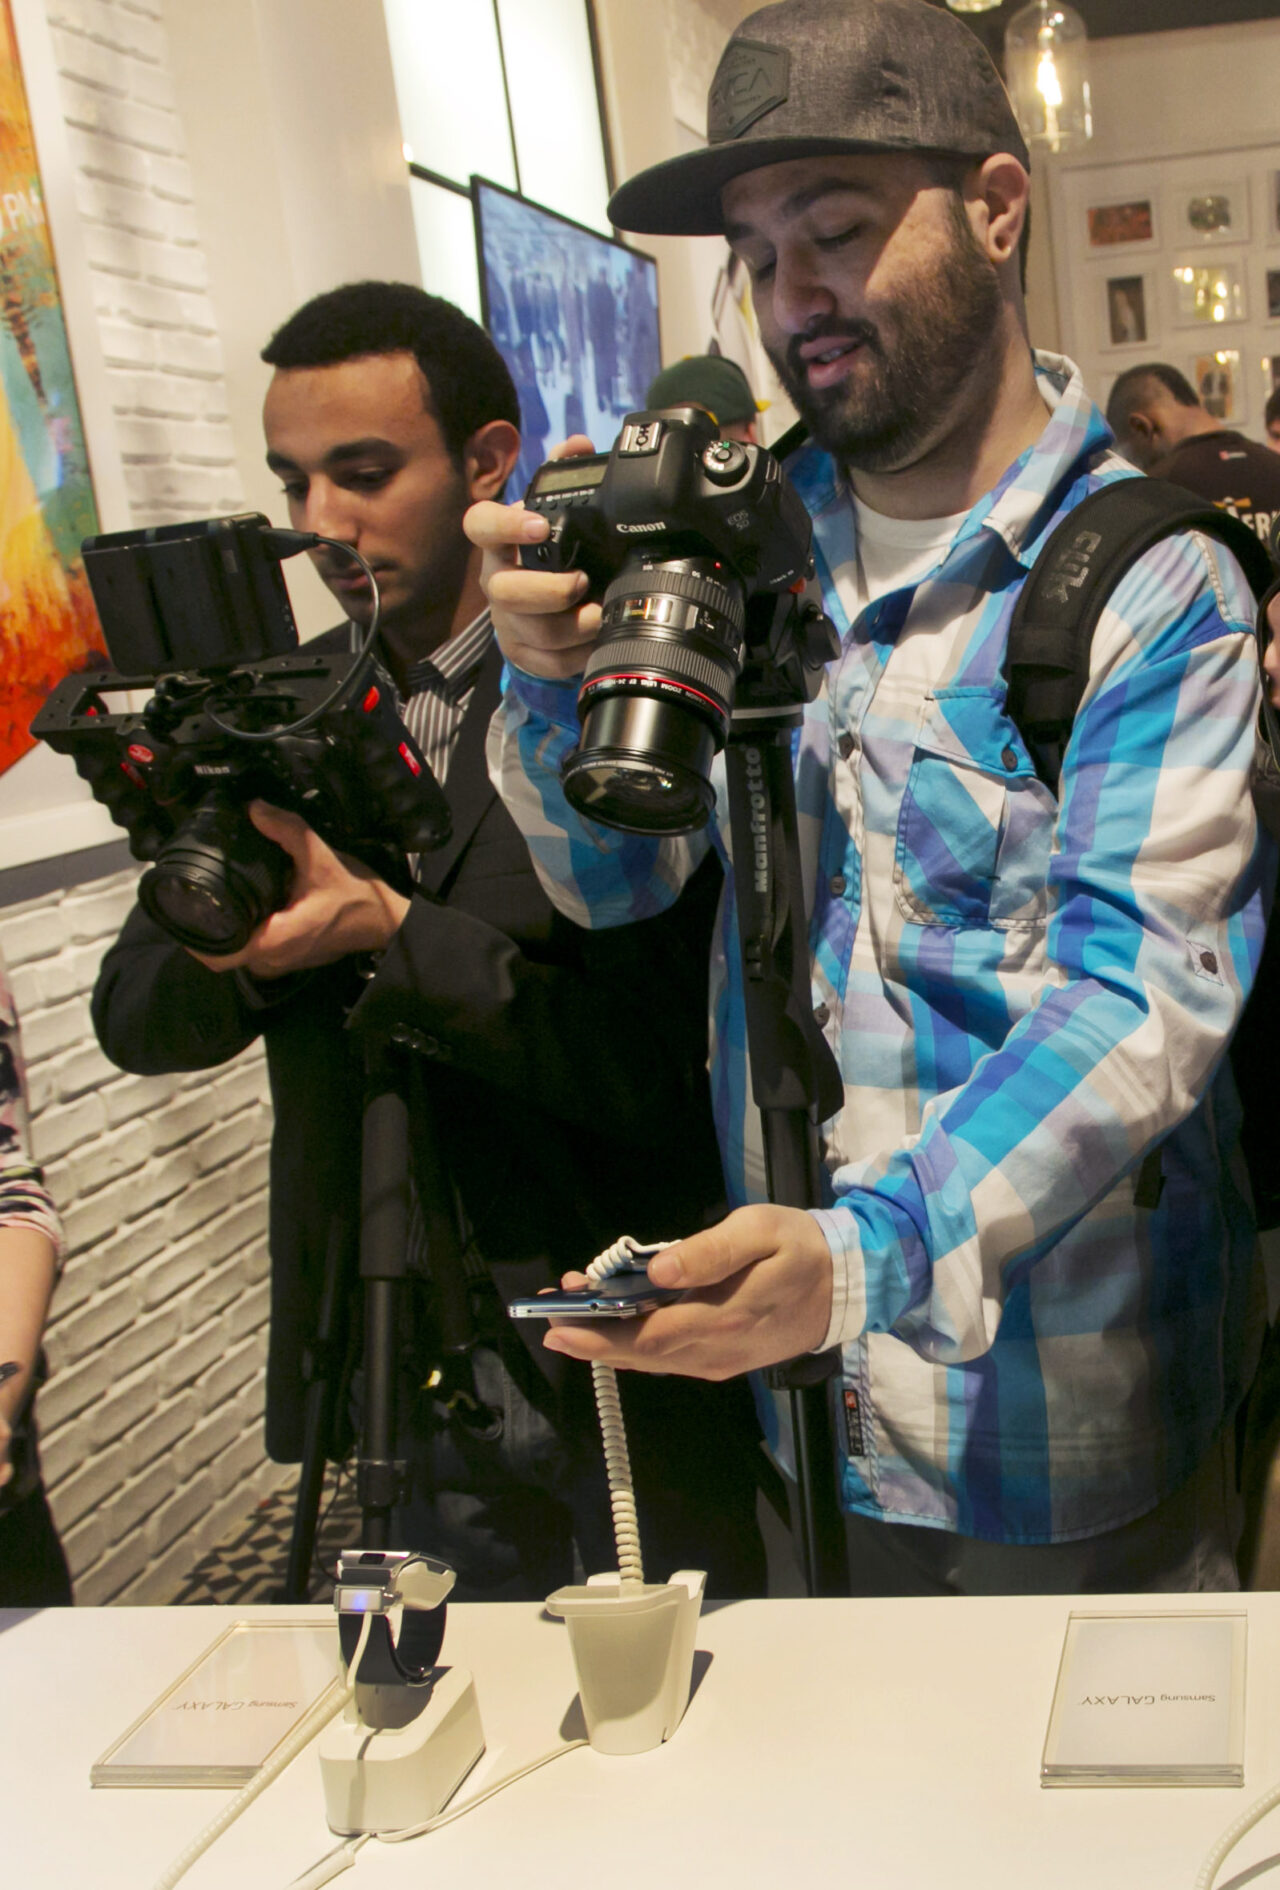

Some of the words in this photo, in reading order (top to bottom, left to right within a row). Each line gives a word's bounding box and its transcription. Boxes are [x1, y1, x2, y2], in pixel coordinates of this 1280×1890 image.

[727, 509, 749, 526] EOS
[616, 521, 667, 534] Canon
[640, 679, 658, 688] LENS
[661, 683, 682, 694] ZOOM
[193, 763, 231, 775] Nikon
[745, 748, 768, 893] Manfrotto
[1081, 1695, 1156, 1705] GALAXY
[1160, 1693, 1216, 1702] Samsung
[177, 1701, 245, 1710] GALAXY
[247, 1700, 298, 1709] Samsung
